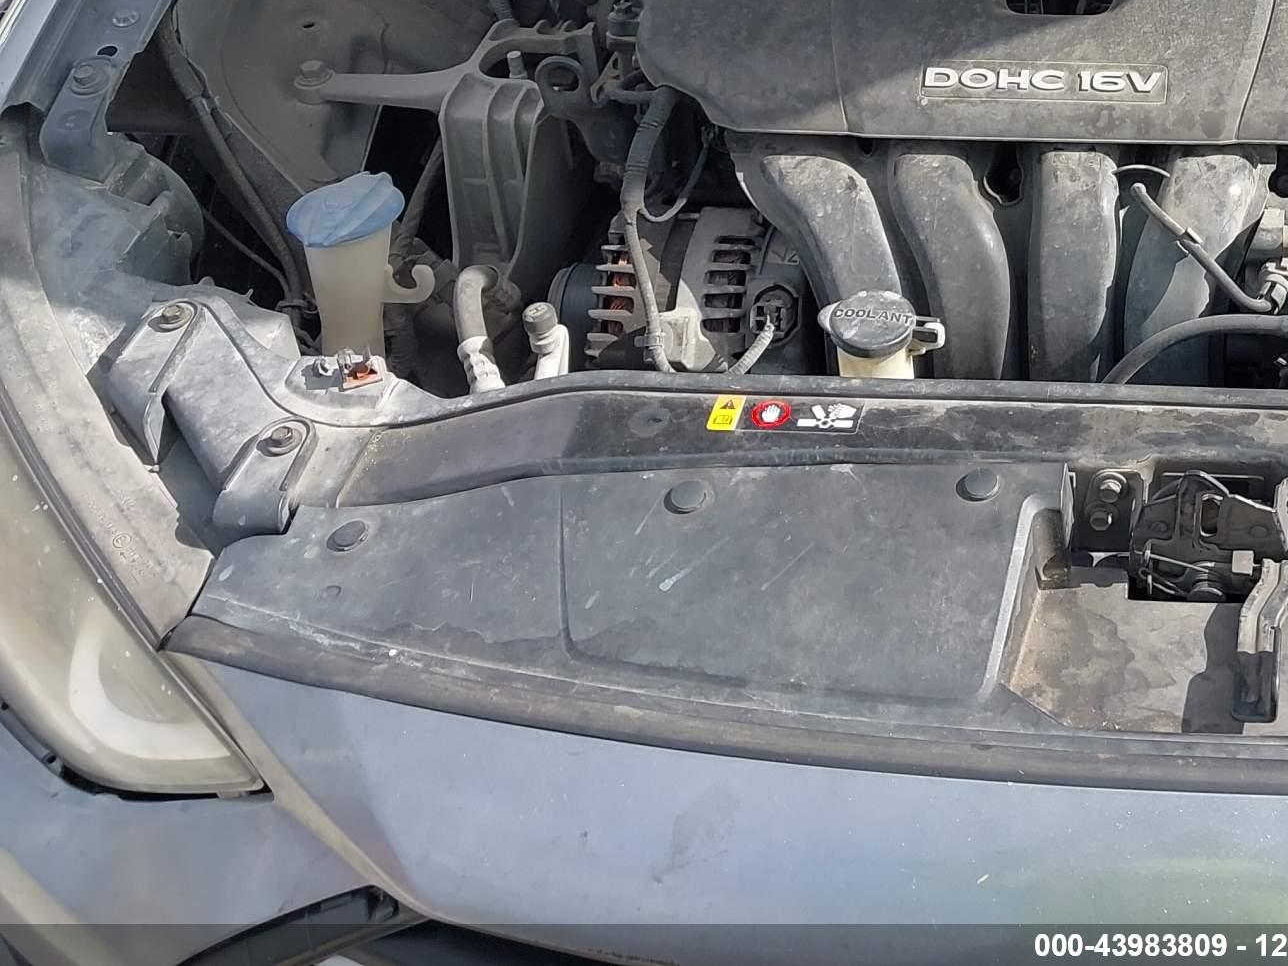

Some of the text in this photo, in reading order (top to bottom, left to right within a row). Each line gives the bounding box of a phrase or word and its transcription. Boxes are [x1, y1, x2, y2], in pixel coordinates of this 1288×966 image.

[922, 66, 1162, 94] DOHC 16V
[833, 308, 913, 326] COOLANT
